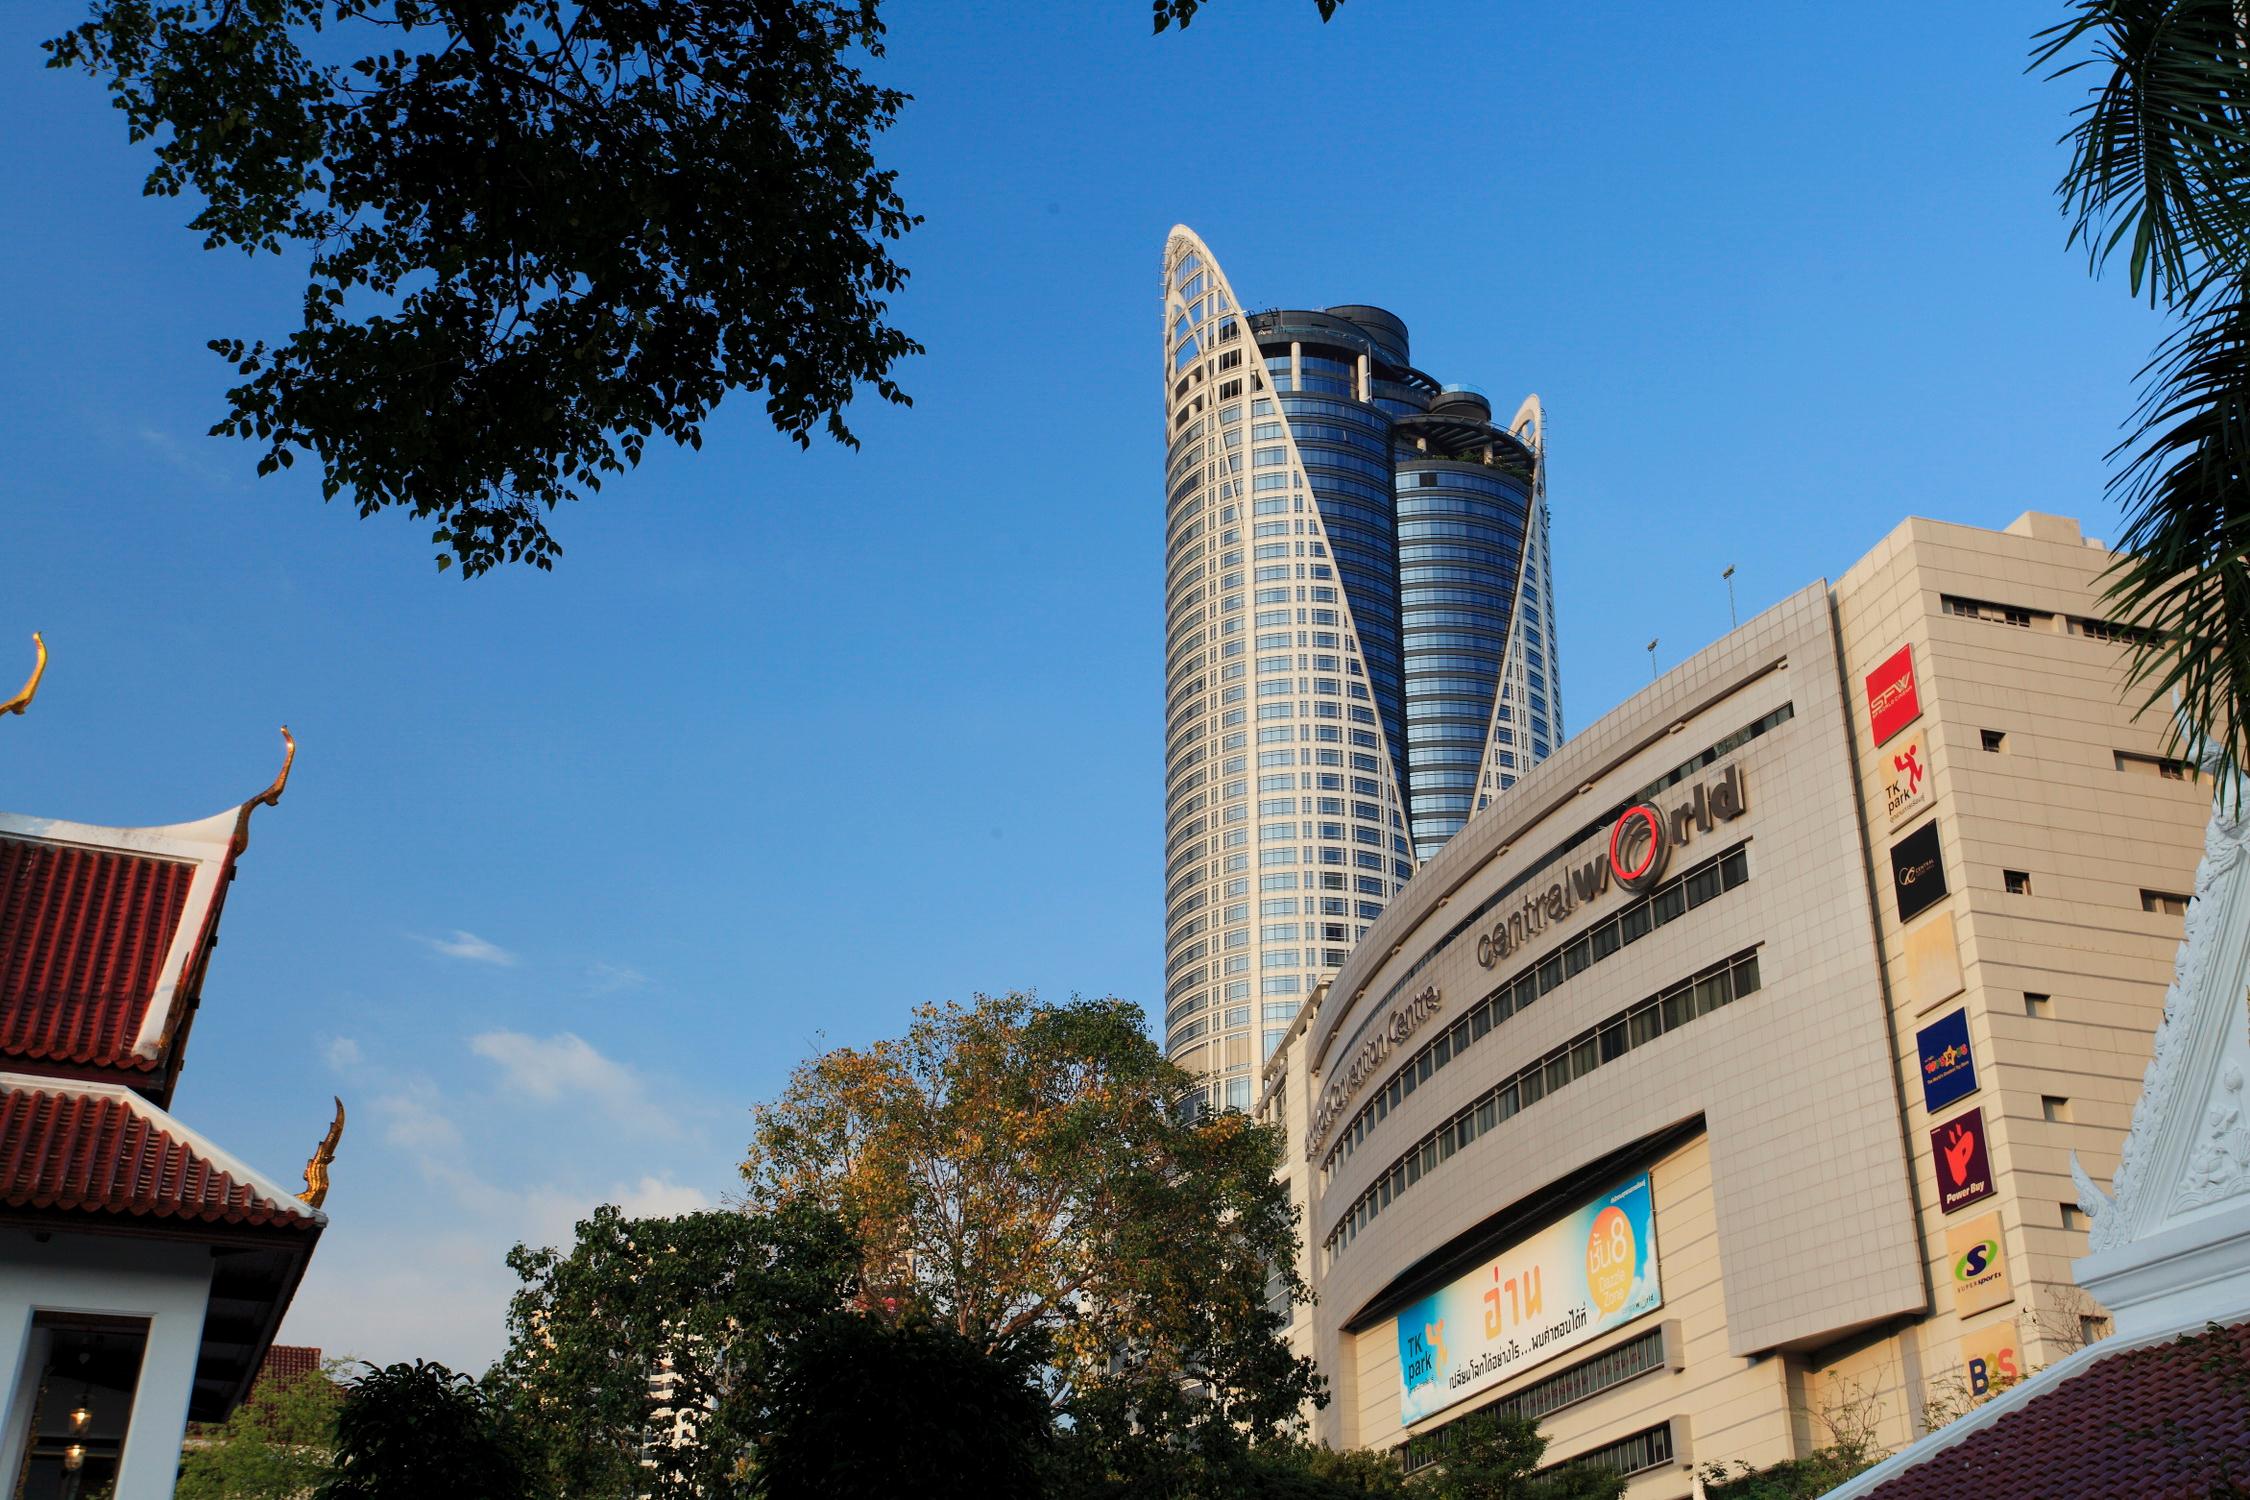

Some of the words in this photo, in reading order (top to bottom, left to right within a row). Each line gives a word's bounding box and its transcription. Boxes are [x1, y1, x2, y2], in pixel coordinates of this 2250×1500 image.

[1885, 780, 1900, 799] TK
[1888, 789, 1911, 815] park
[1388, 985, 1441, 1043] Centre
[1946, 1187, 1970, 1205] Power
[1970, 1180, 1985, 1195] Buy
[1484, 1265, 1543, 1341] อ่าน
[1408, 1332, 1422, 1358] TK
[1409, 1350, 1432, 1386] park
